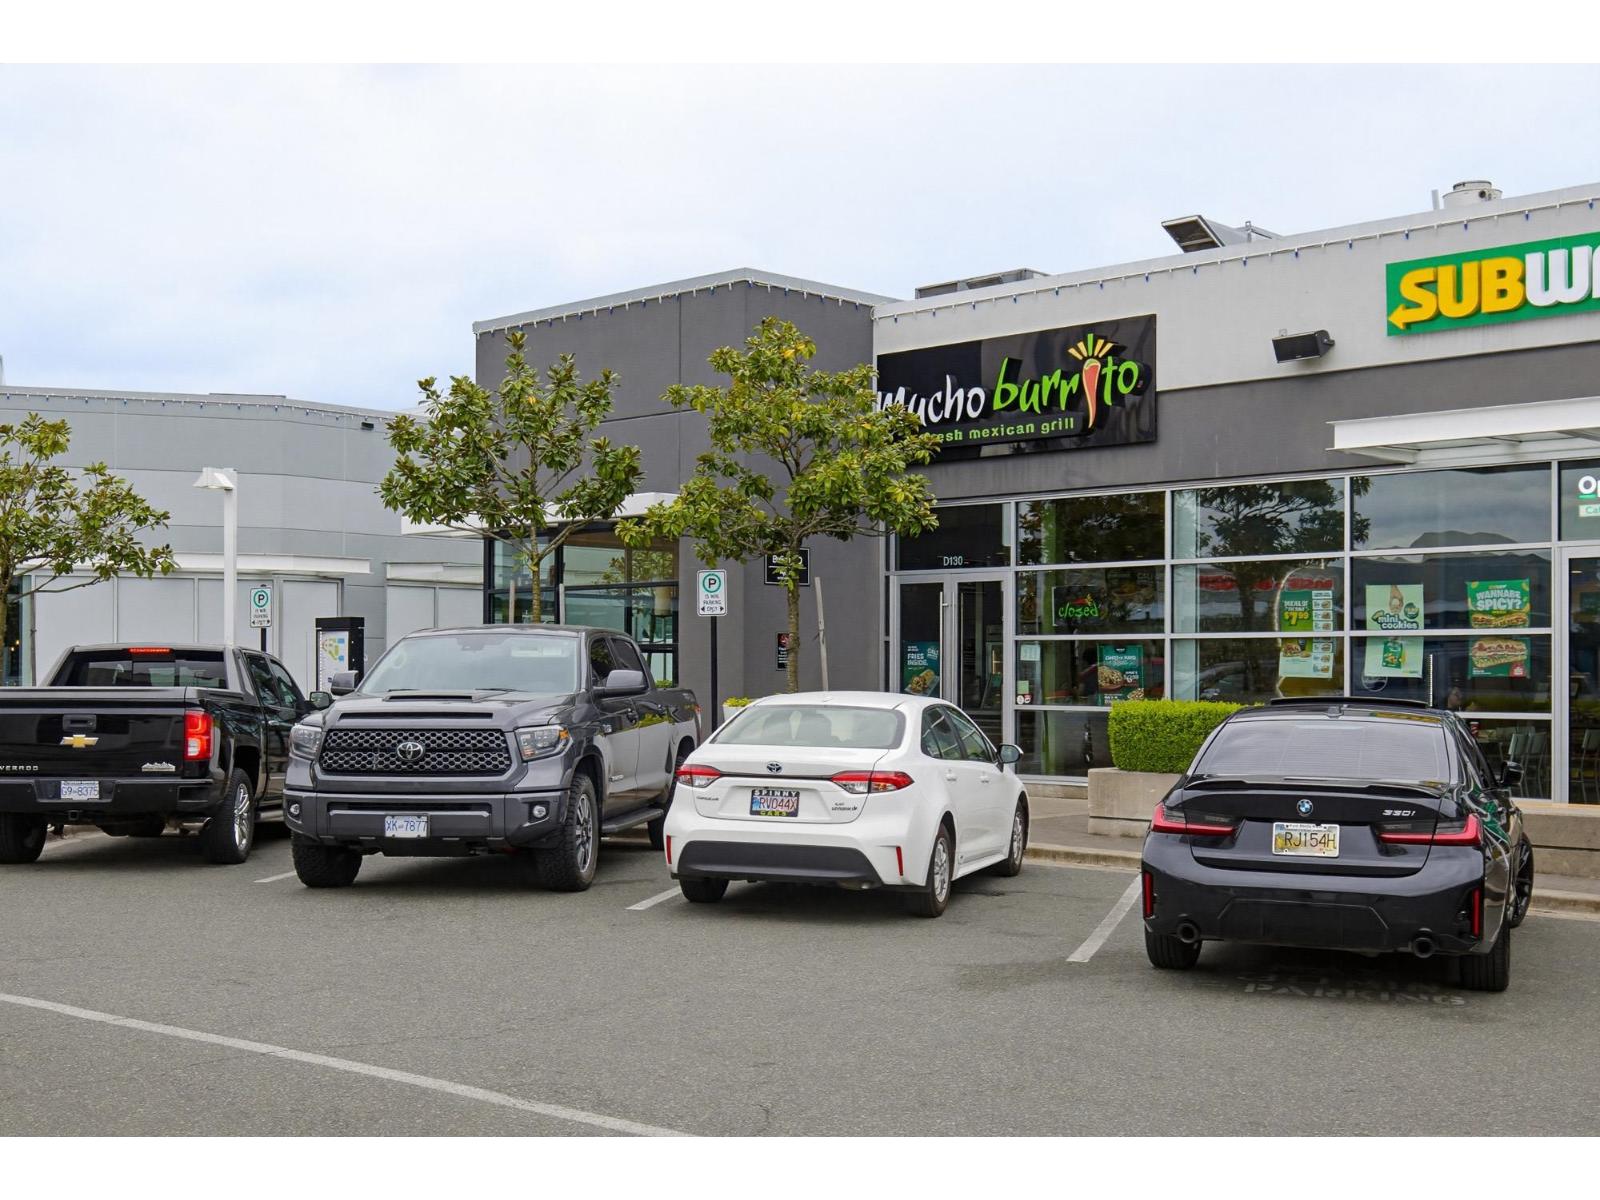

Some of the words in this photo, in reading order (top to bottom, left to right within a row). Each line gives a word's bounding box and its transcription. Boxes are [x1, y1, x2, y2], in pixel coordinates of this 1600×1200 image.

[1388, 245, 1600, 330] SUBW
[993, 355, 1139, 429] burrito
[969, 424, 1035, 440] mexican
[1041, 417, 1075, 434] grill
[943, 556, 963, 566] D130
[1058, 601, 1099, 618] closed
[1476, 598, 1522, 611] SPICY?
[1378, 614, 1399, 623] mini
[1382, 620, 1418, 629] cookies
